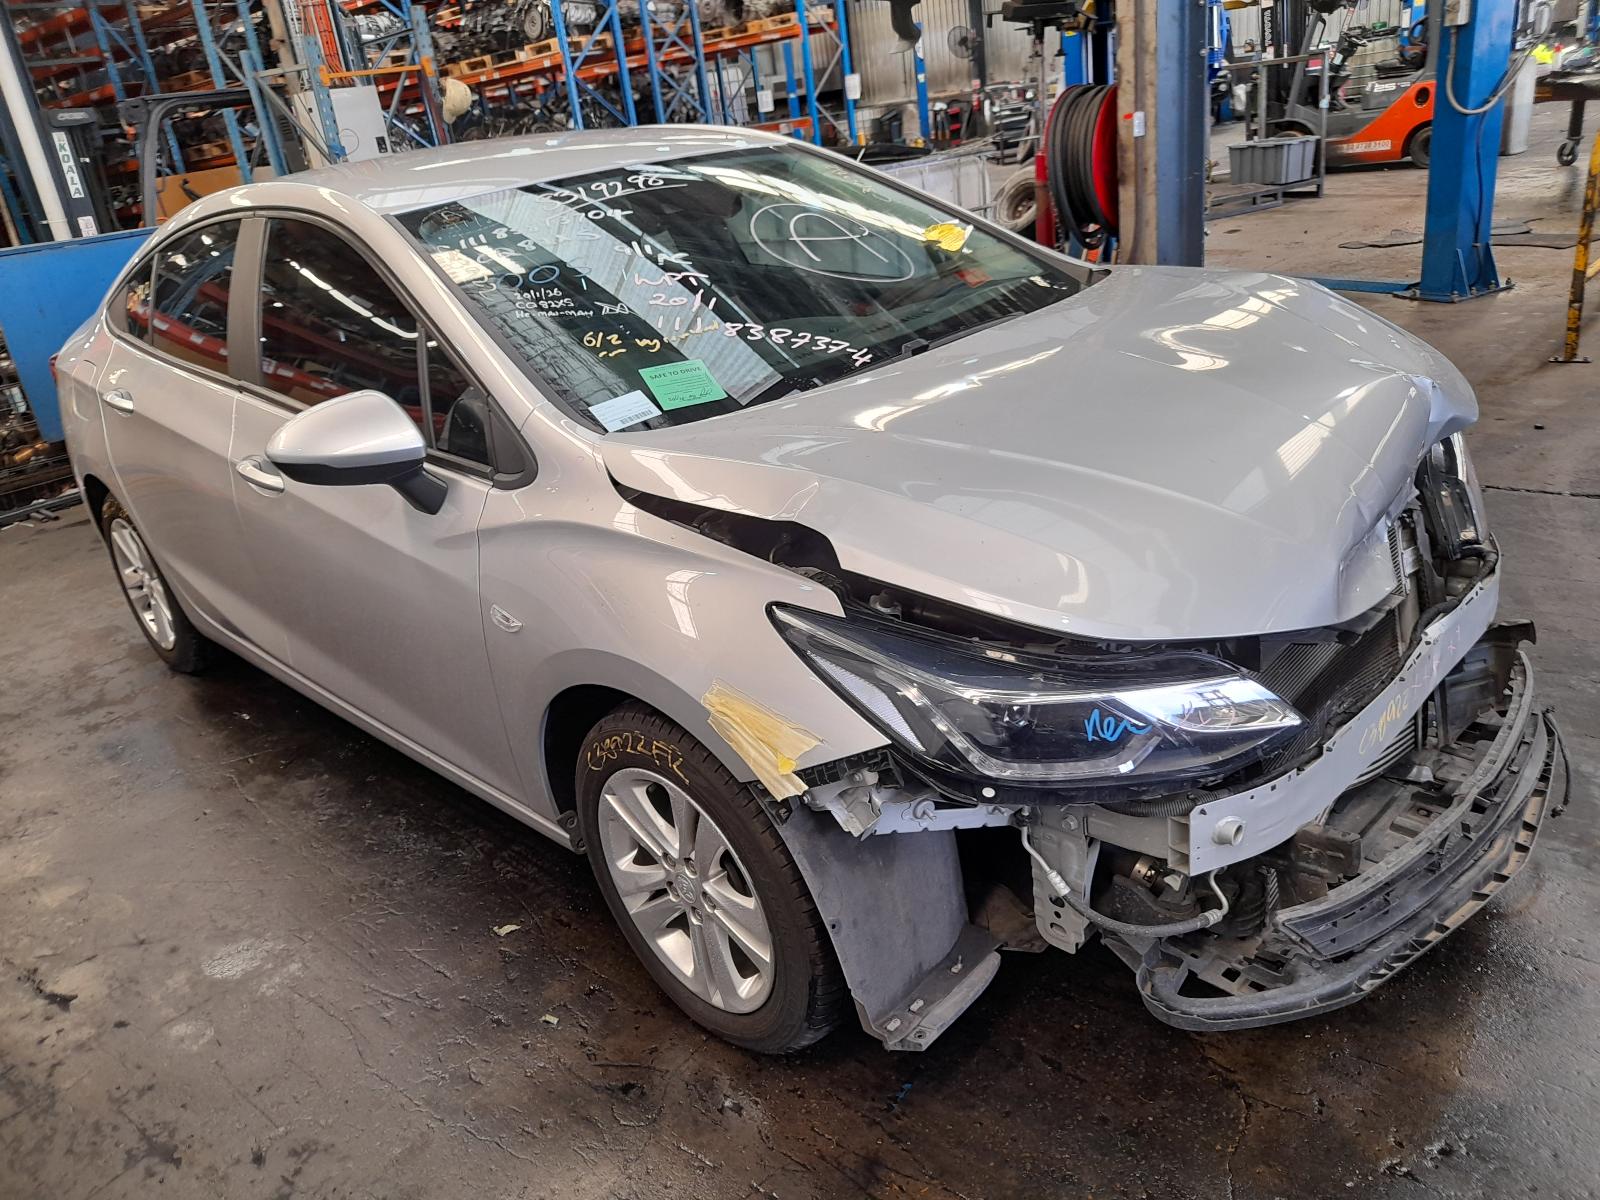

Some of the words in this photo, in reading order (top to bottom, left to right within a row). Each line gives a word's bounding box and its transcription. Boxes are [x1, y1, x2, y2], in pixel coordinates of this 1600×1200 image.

[1263, 9, 1272, 47] TOYOTA
[58, 142, 83, 198] KOALA
[649, 371, 668, 380] SAFE
[680, 366, 701, 375] DRIVE
